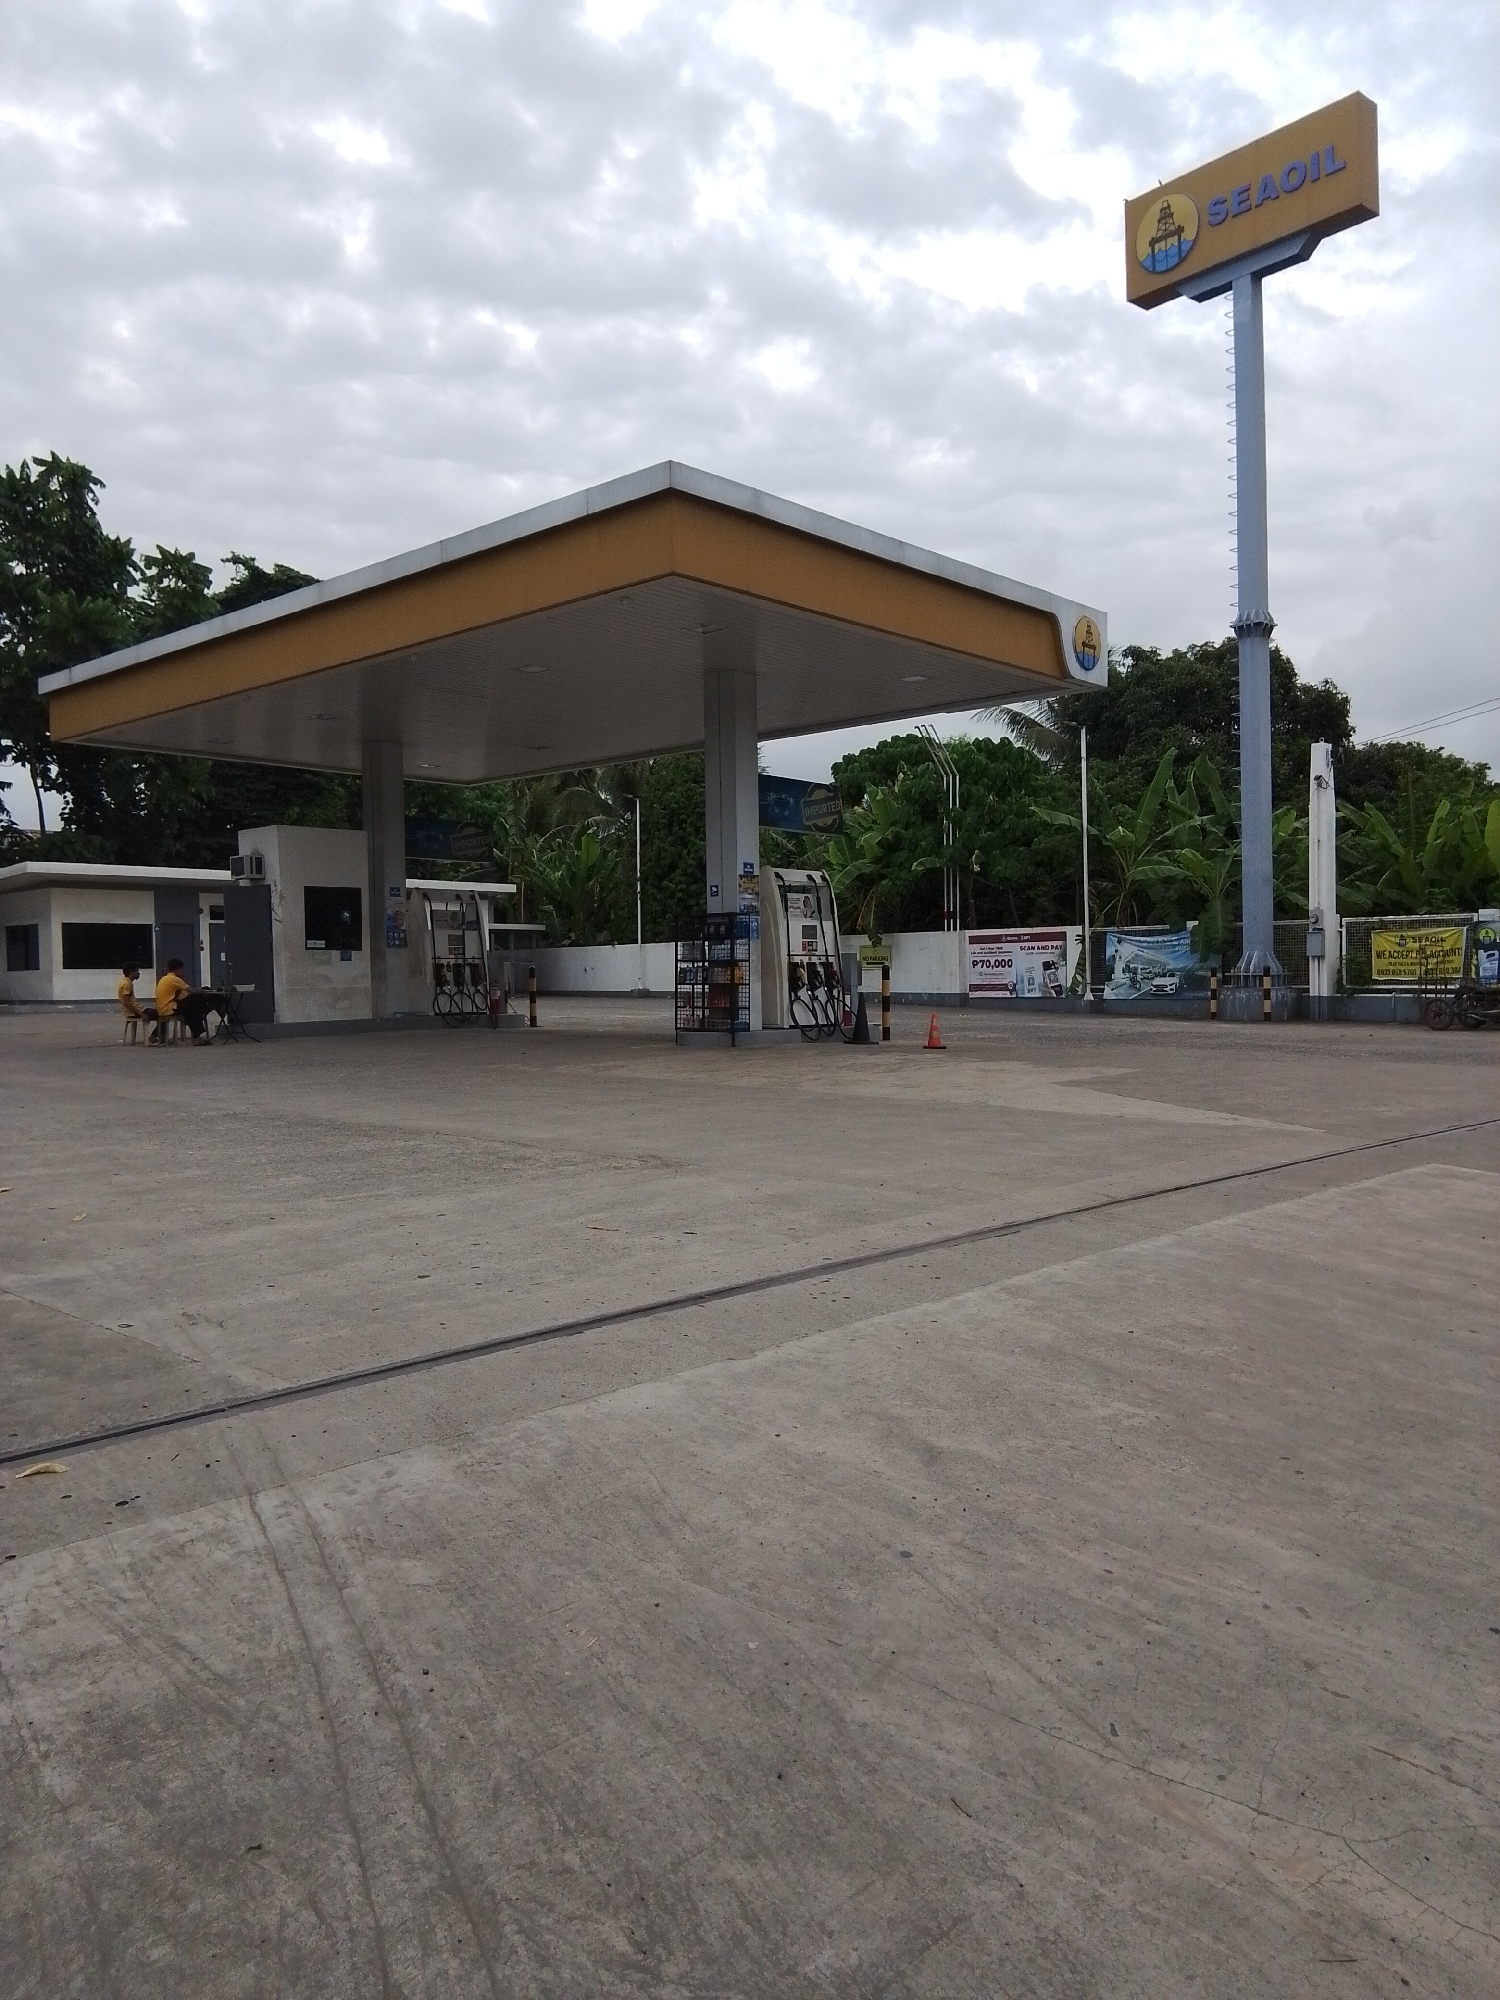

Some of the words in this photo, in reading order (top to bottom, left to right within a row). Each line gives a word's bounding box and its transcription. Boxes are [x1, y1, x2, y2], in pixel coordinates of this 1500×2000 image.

[1207, 145, 1346, 226] SEAOIL
[804, 800, 840, 817] IMPORTED
[453, 835, 491, 850] IMPORTED
[1376, 950, 1386, 959] WE
[1388, 950, 1413, 959] ACCEPT
